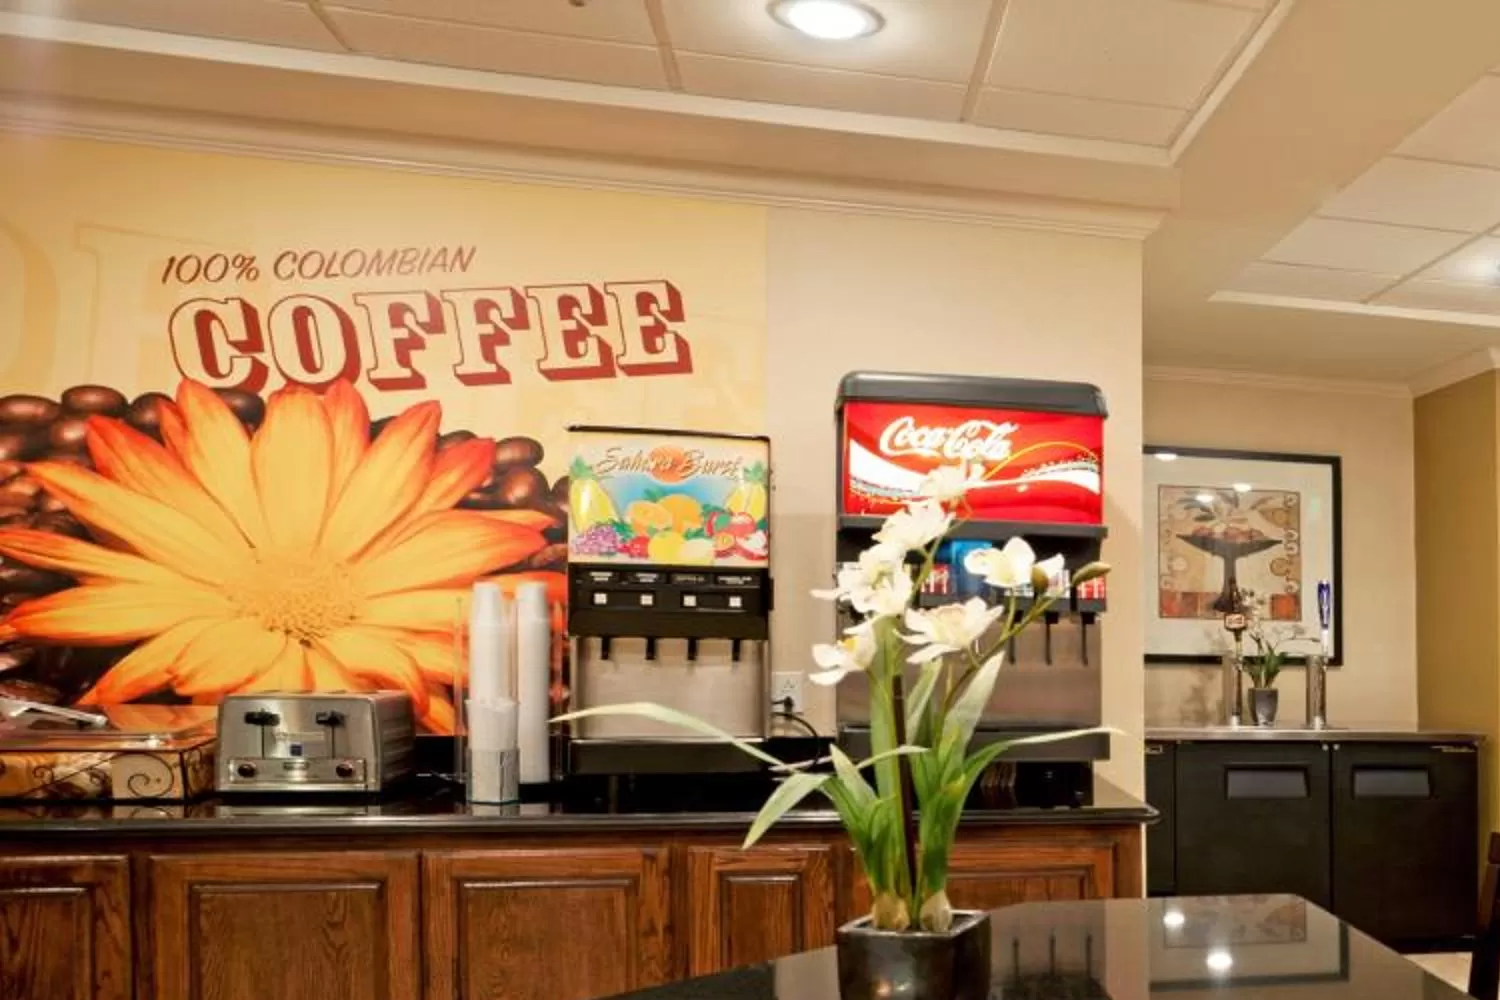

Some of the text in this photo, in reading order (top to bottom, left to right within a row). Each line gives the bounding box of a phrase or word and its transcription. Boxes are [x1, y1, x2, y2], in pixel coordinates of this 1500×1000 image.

[161, 246, 477, 284] 100% COLOMBIAN
[168, 280, 694, 395] COFFEE
[680, 449, 743, 480] Burst
